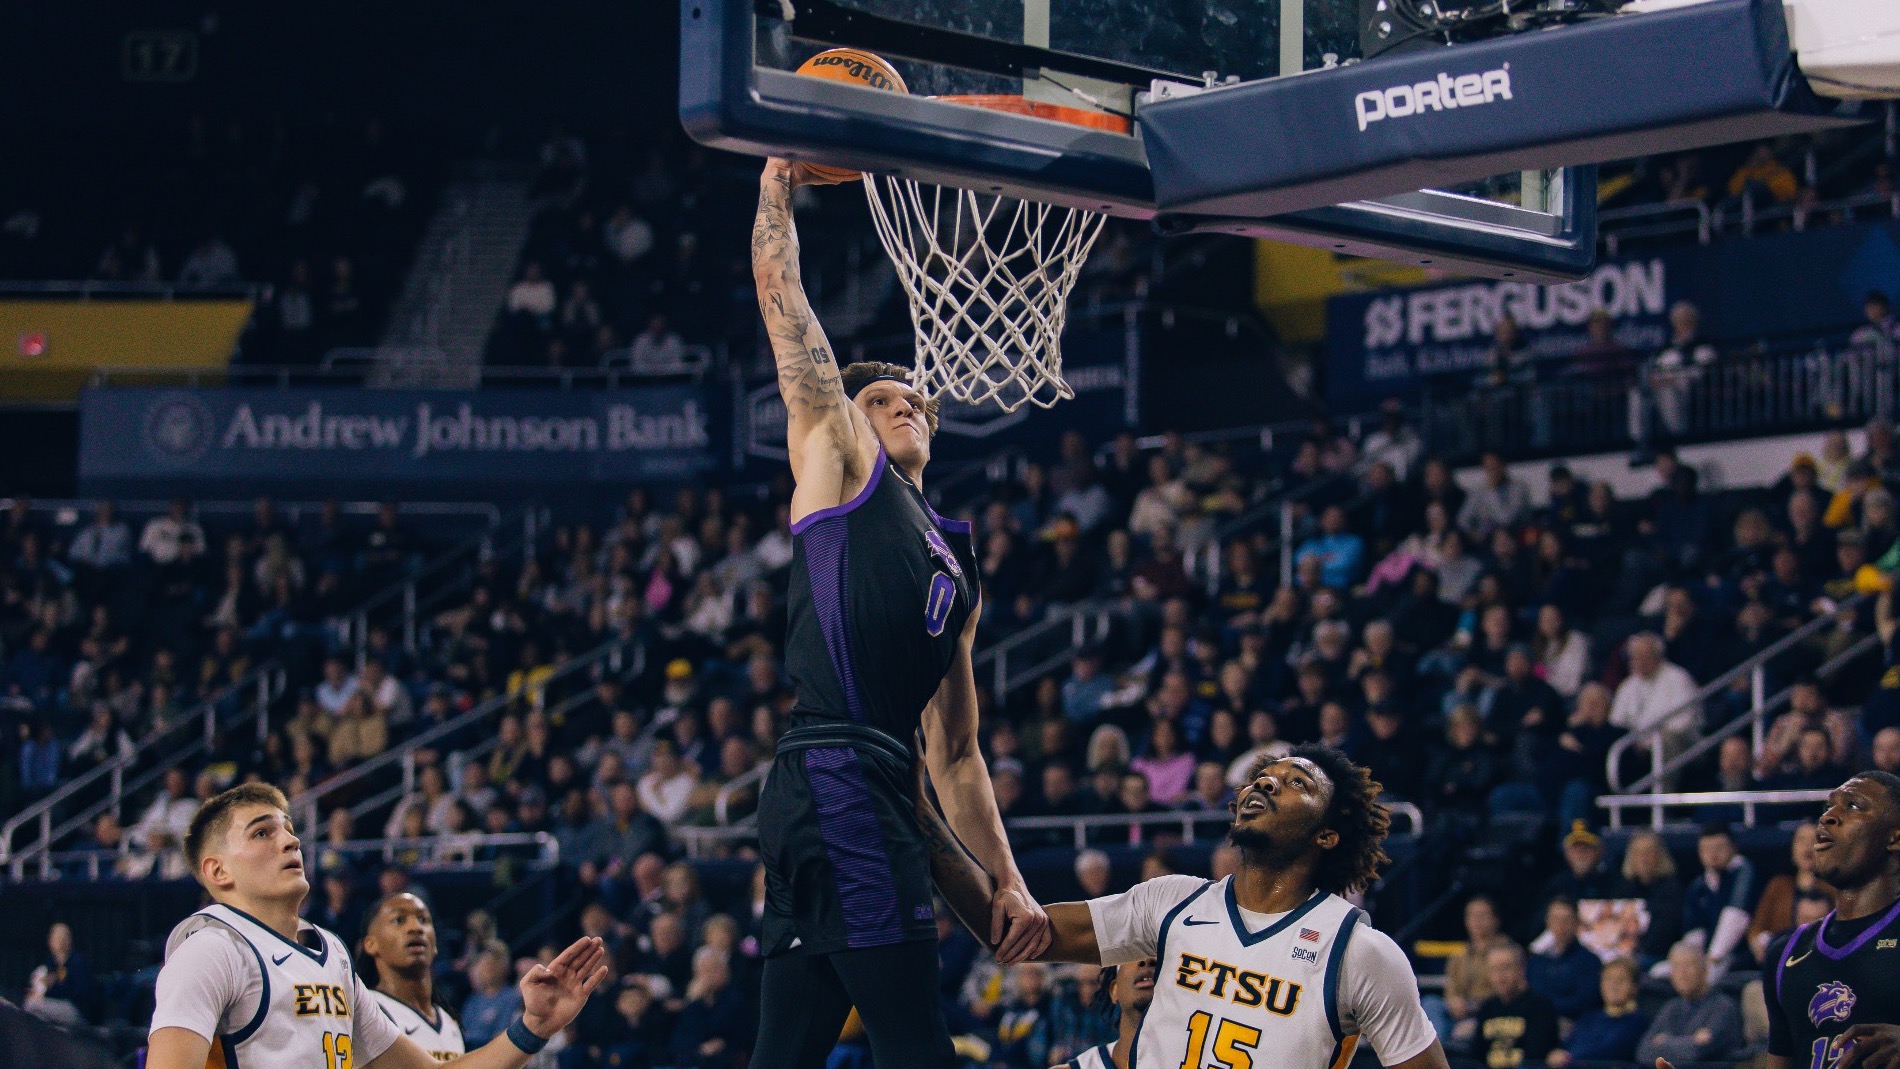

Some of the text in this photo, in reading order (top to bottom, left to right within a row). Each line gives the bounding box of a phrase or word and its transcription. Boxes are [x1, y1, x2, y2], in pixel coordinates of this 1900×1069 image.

[138, 40, 182, 71] 17
[813, 56, 894, 91] Wilson
[1407, 258, 1666, 346] FERGUSON
[222, 400, 408, 450] Andrew
[412, 402, 599, 458] Johnson
[605, 399, 709, 450] Bank
[925, 570, 957, 637] 0
[293, 984, 351, 1018] ETS
[1176, 951, 1303, 1017] ETSU
[1179, 1009, 1263, 1069] 15
